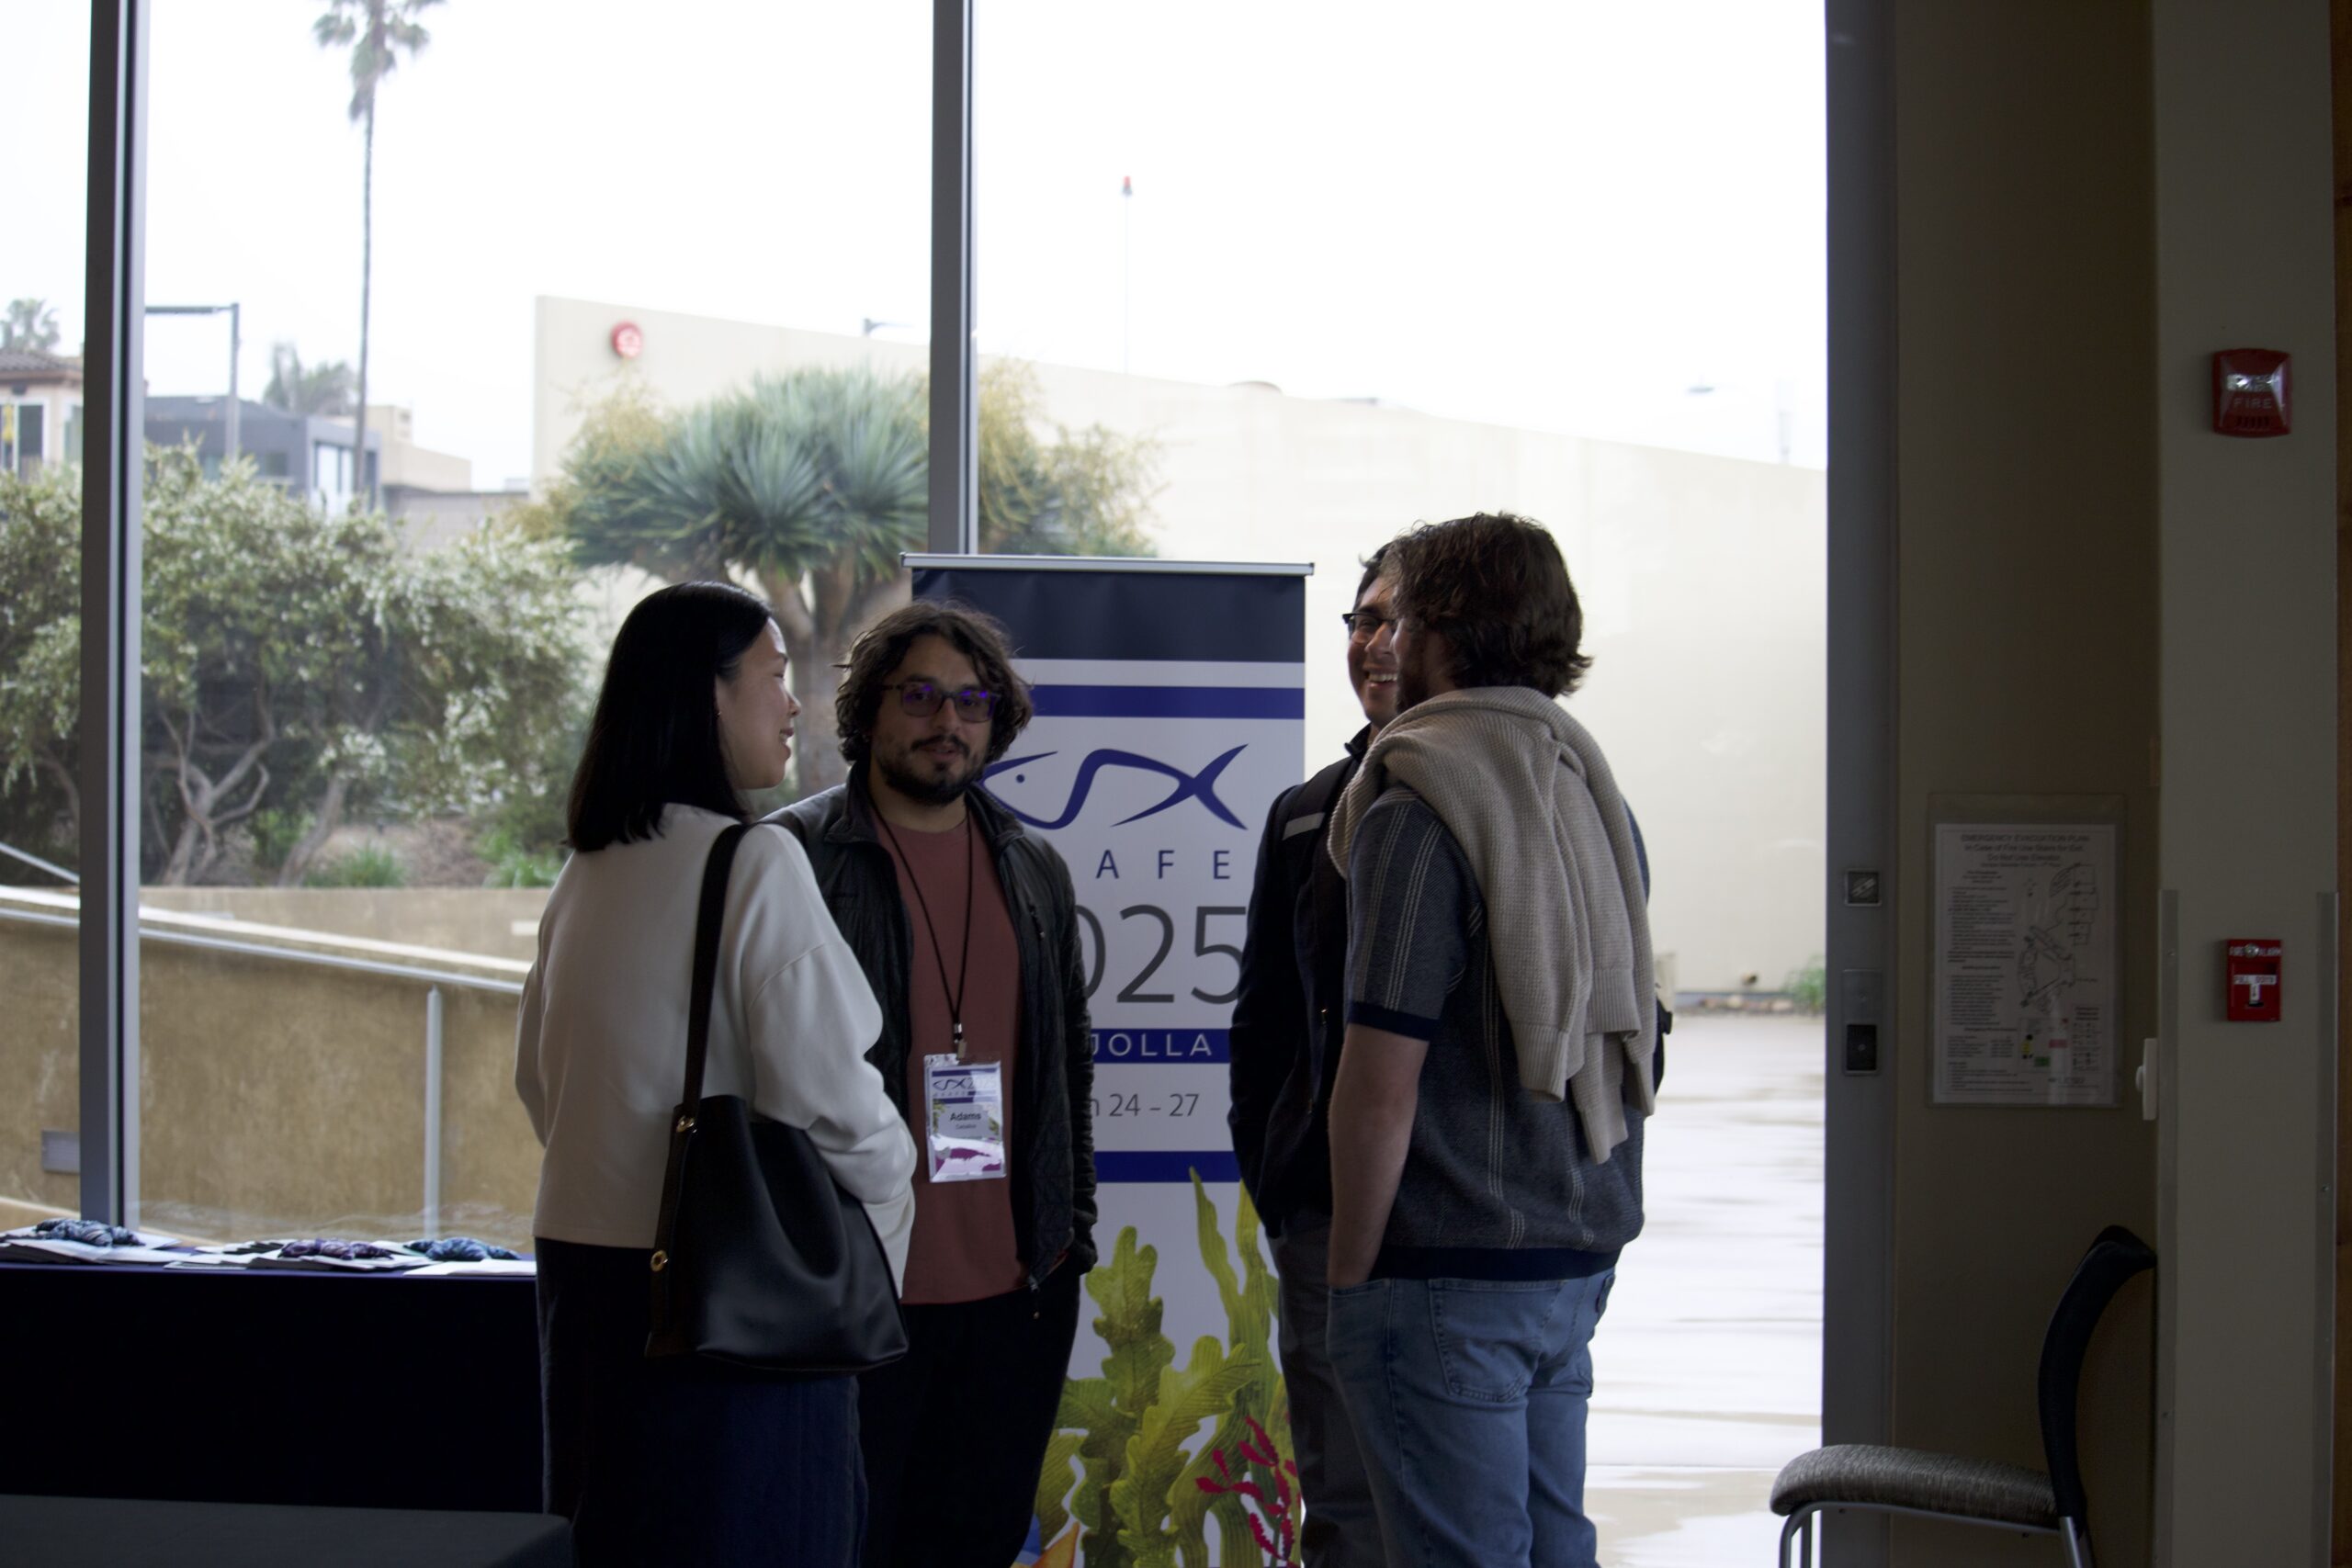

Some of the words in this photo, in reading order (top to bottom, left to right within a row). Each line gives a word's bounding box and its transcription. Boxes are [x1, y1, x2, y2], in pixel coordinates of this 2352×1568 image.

[1096, 850, 1230, 879] AFE
[1075, 905, 1246, 1004] 25
[1091, 1033, 1213, 1056] JOLLA
[949, 1111, 981, 1122] Adams
[1109, 1093, 1141, 1117] 24
[1169, 1093, 1200, 1117] 27
